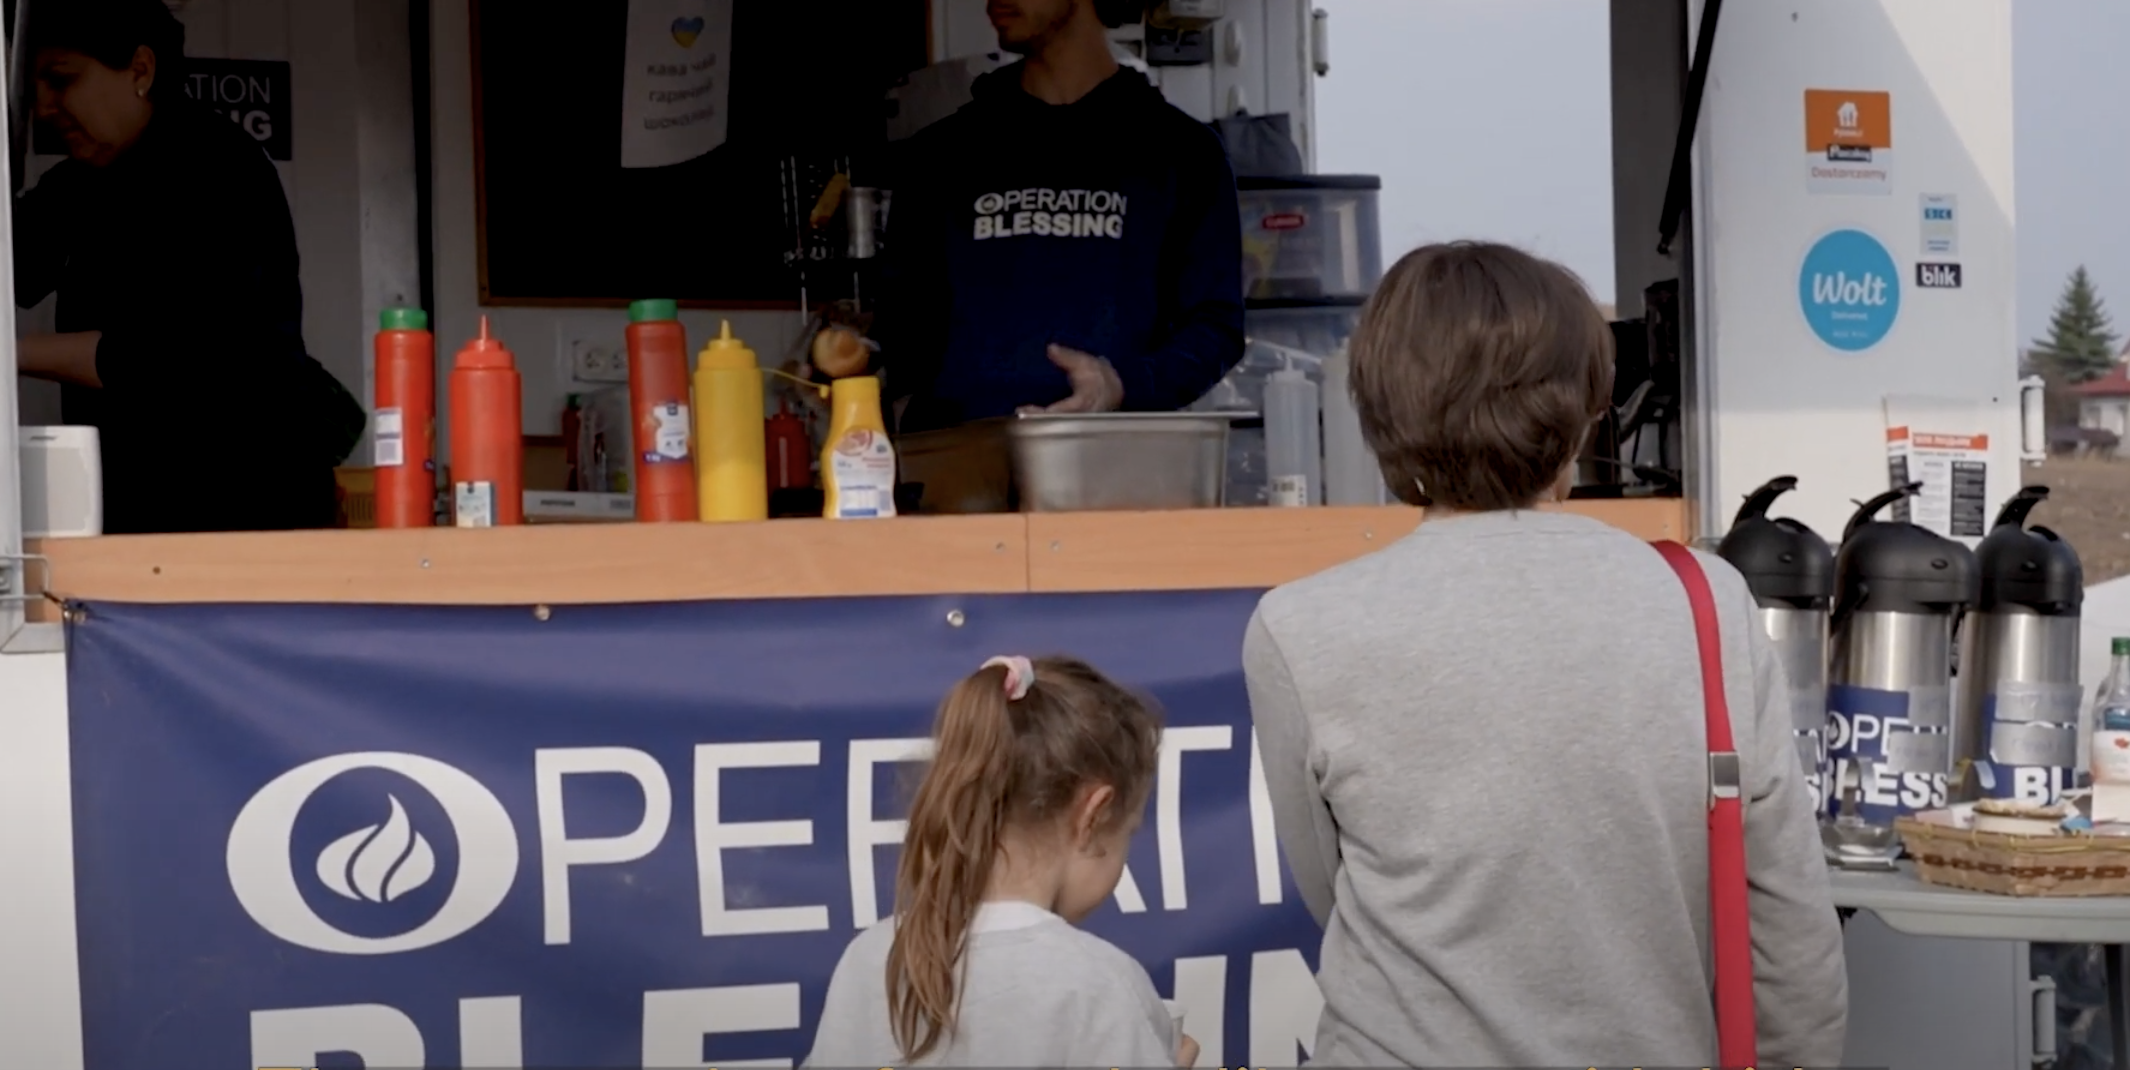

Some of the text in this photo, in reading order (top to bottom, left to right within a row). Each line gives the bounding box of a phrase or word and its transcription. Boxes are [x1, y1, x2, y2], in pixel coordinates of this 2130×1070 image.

[647, 63, 687, 77] кава
[1811, 165, 1887, 182] Dostarczamy
[973, 188, 1127, 216] OPERATION
[973, 211, 1123, 240] BLESSING
[1920, 264, 1957, 286] blik
[1812, 271, 1888, 305] Wolt
